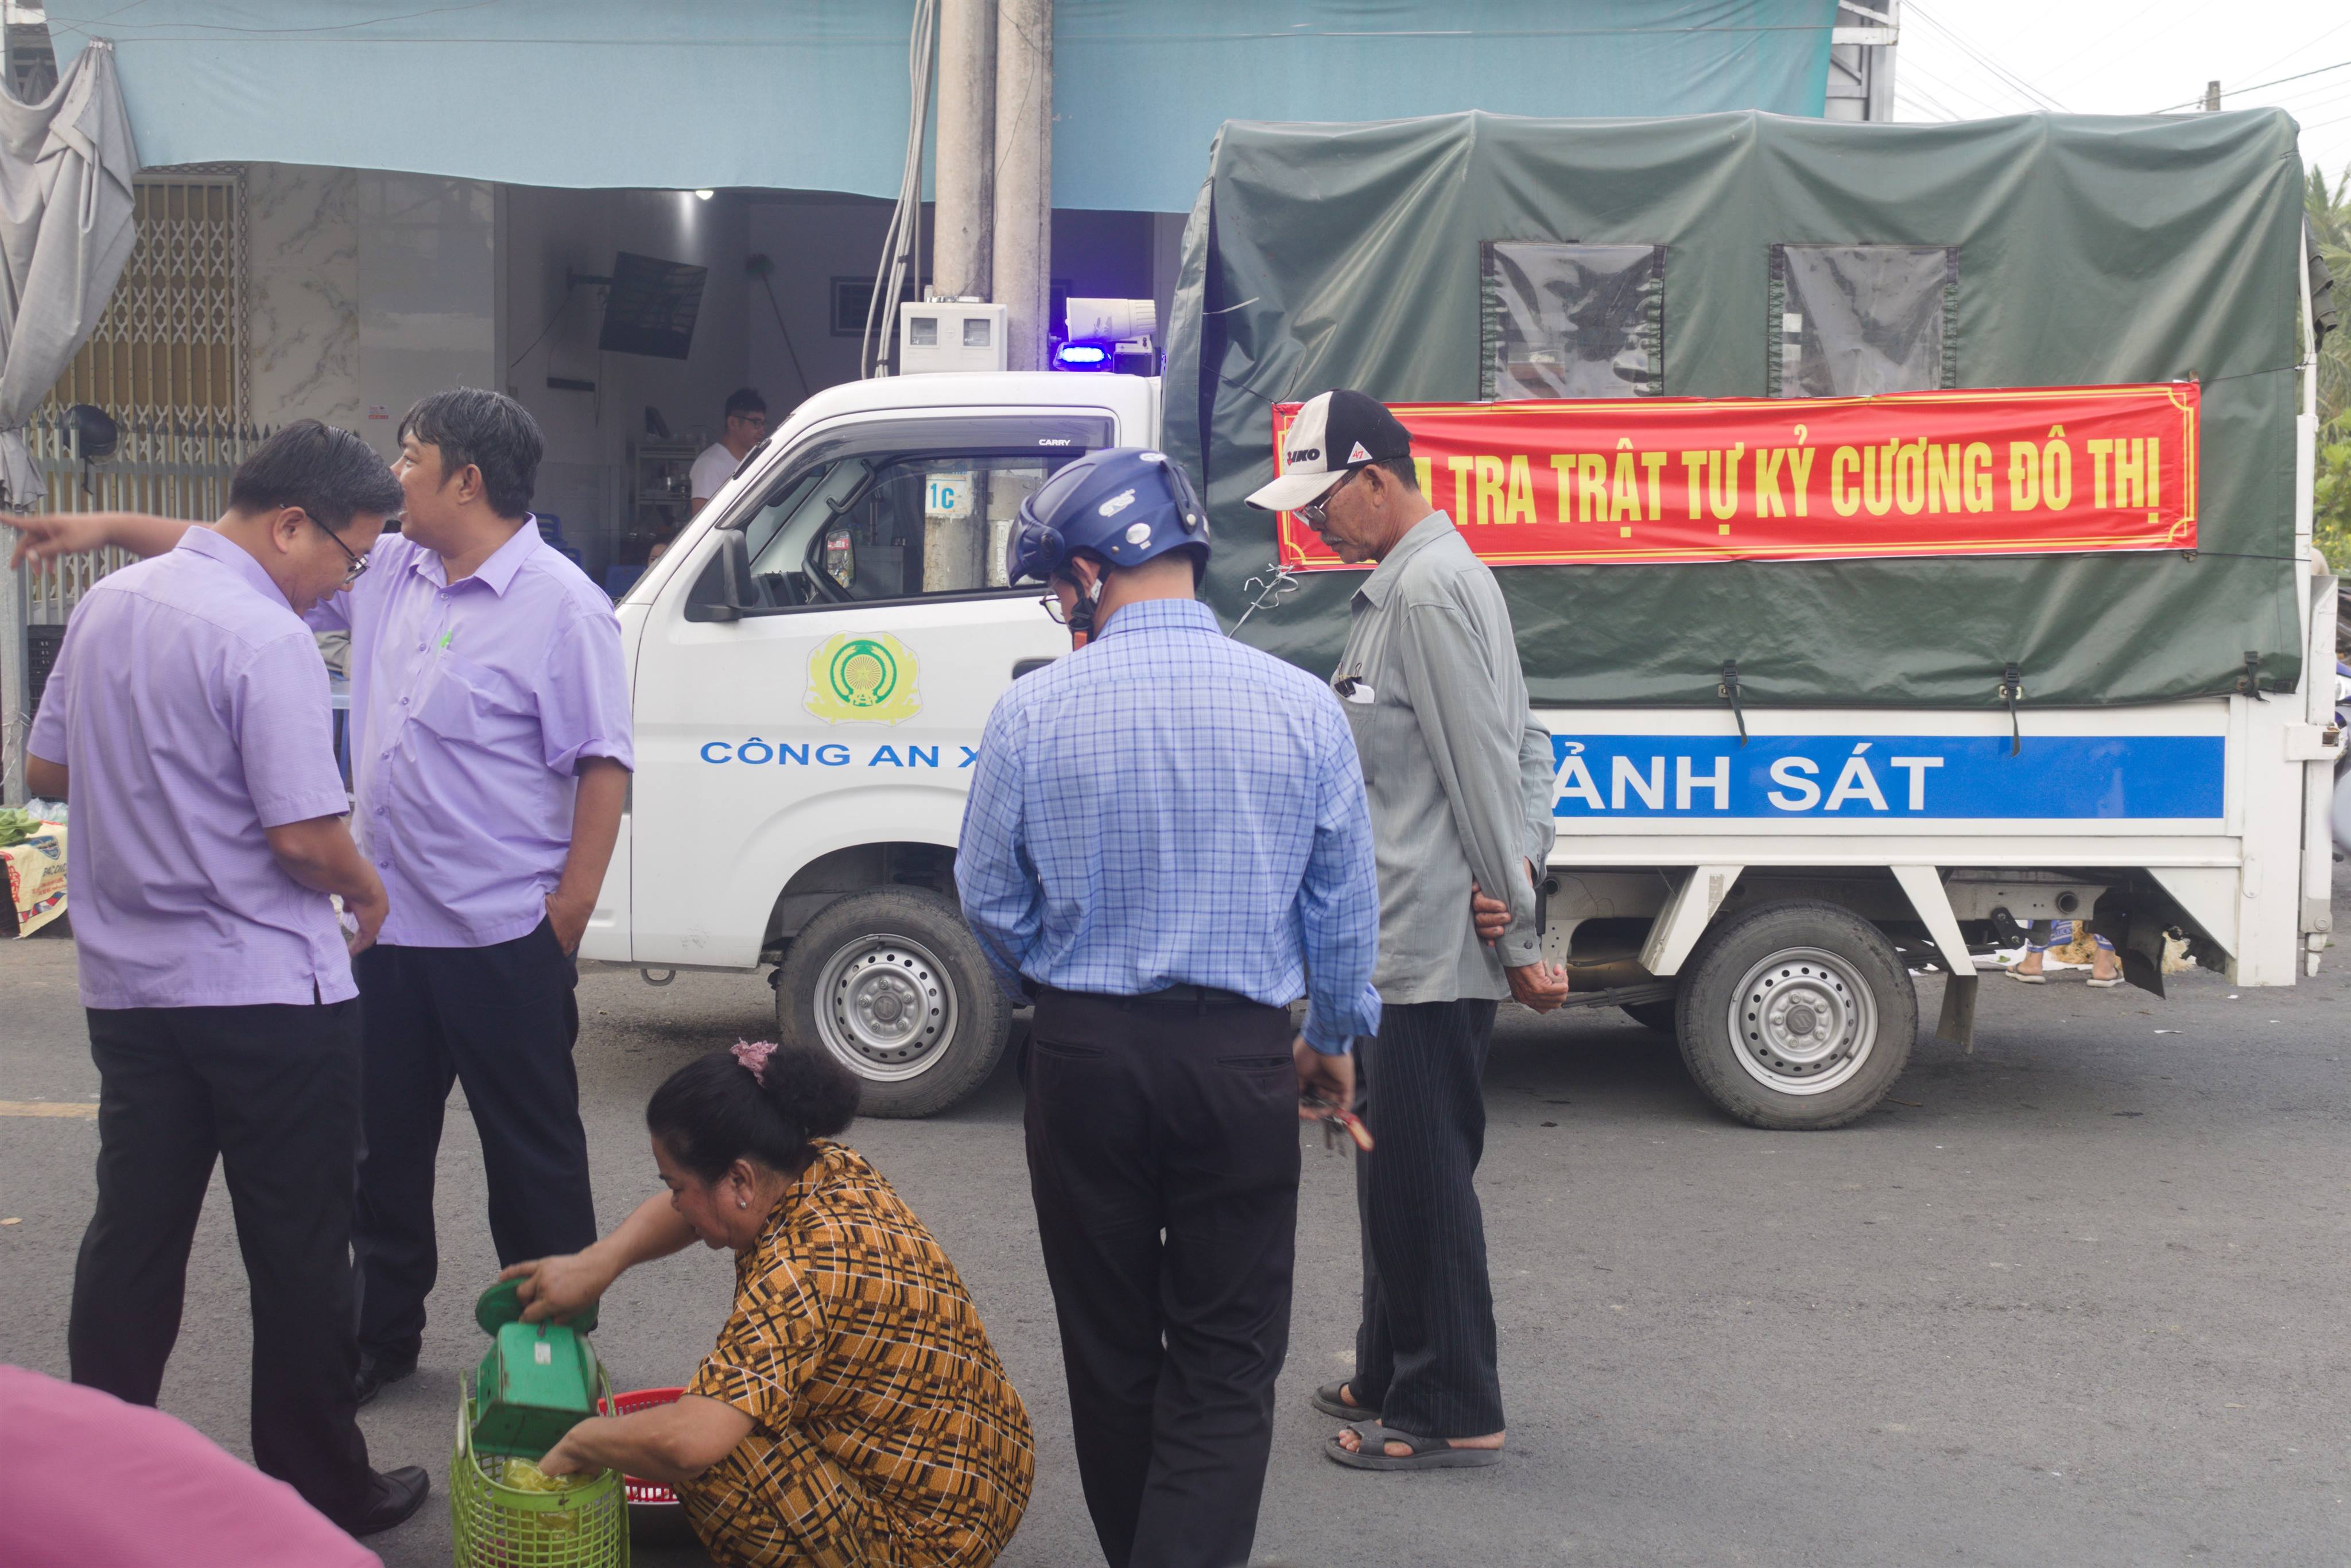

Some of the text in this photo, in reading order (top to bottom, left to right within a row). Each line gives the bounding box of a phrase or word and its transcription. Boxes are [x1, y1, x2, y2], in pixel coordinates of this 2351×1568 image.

[1352, 450, 1364, 459] 47
[1448, 455, 1537, 525] TRA
[1551, 438, 1666, 538] TRẬT
[1682, 442, 1744, 535] TỰ
[1755, 424, 1815, 518] KỶ
[1831, 437, 1993, 517] CƯƠNG
[2008, 425, 2071, 511] ĐÔ
[2088, 437, 2160, 523] THỊ
[700, 737, 979, 768] CÔNG AN X
[1552, 742, 1945, 811] ẢNH SÁT
